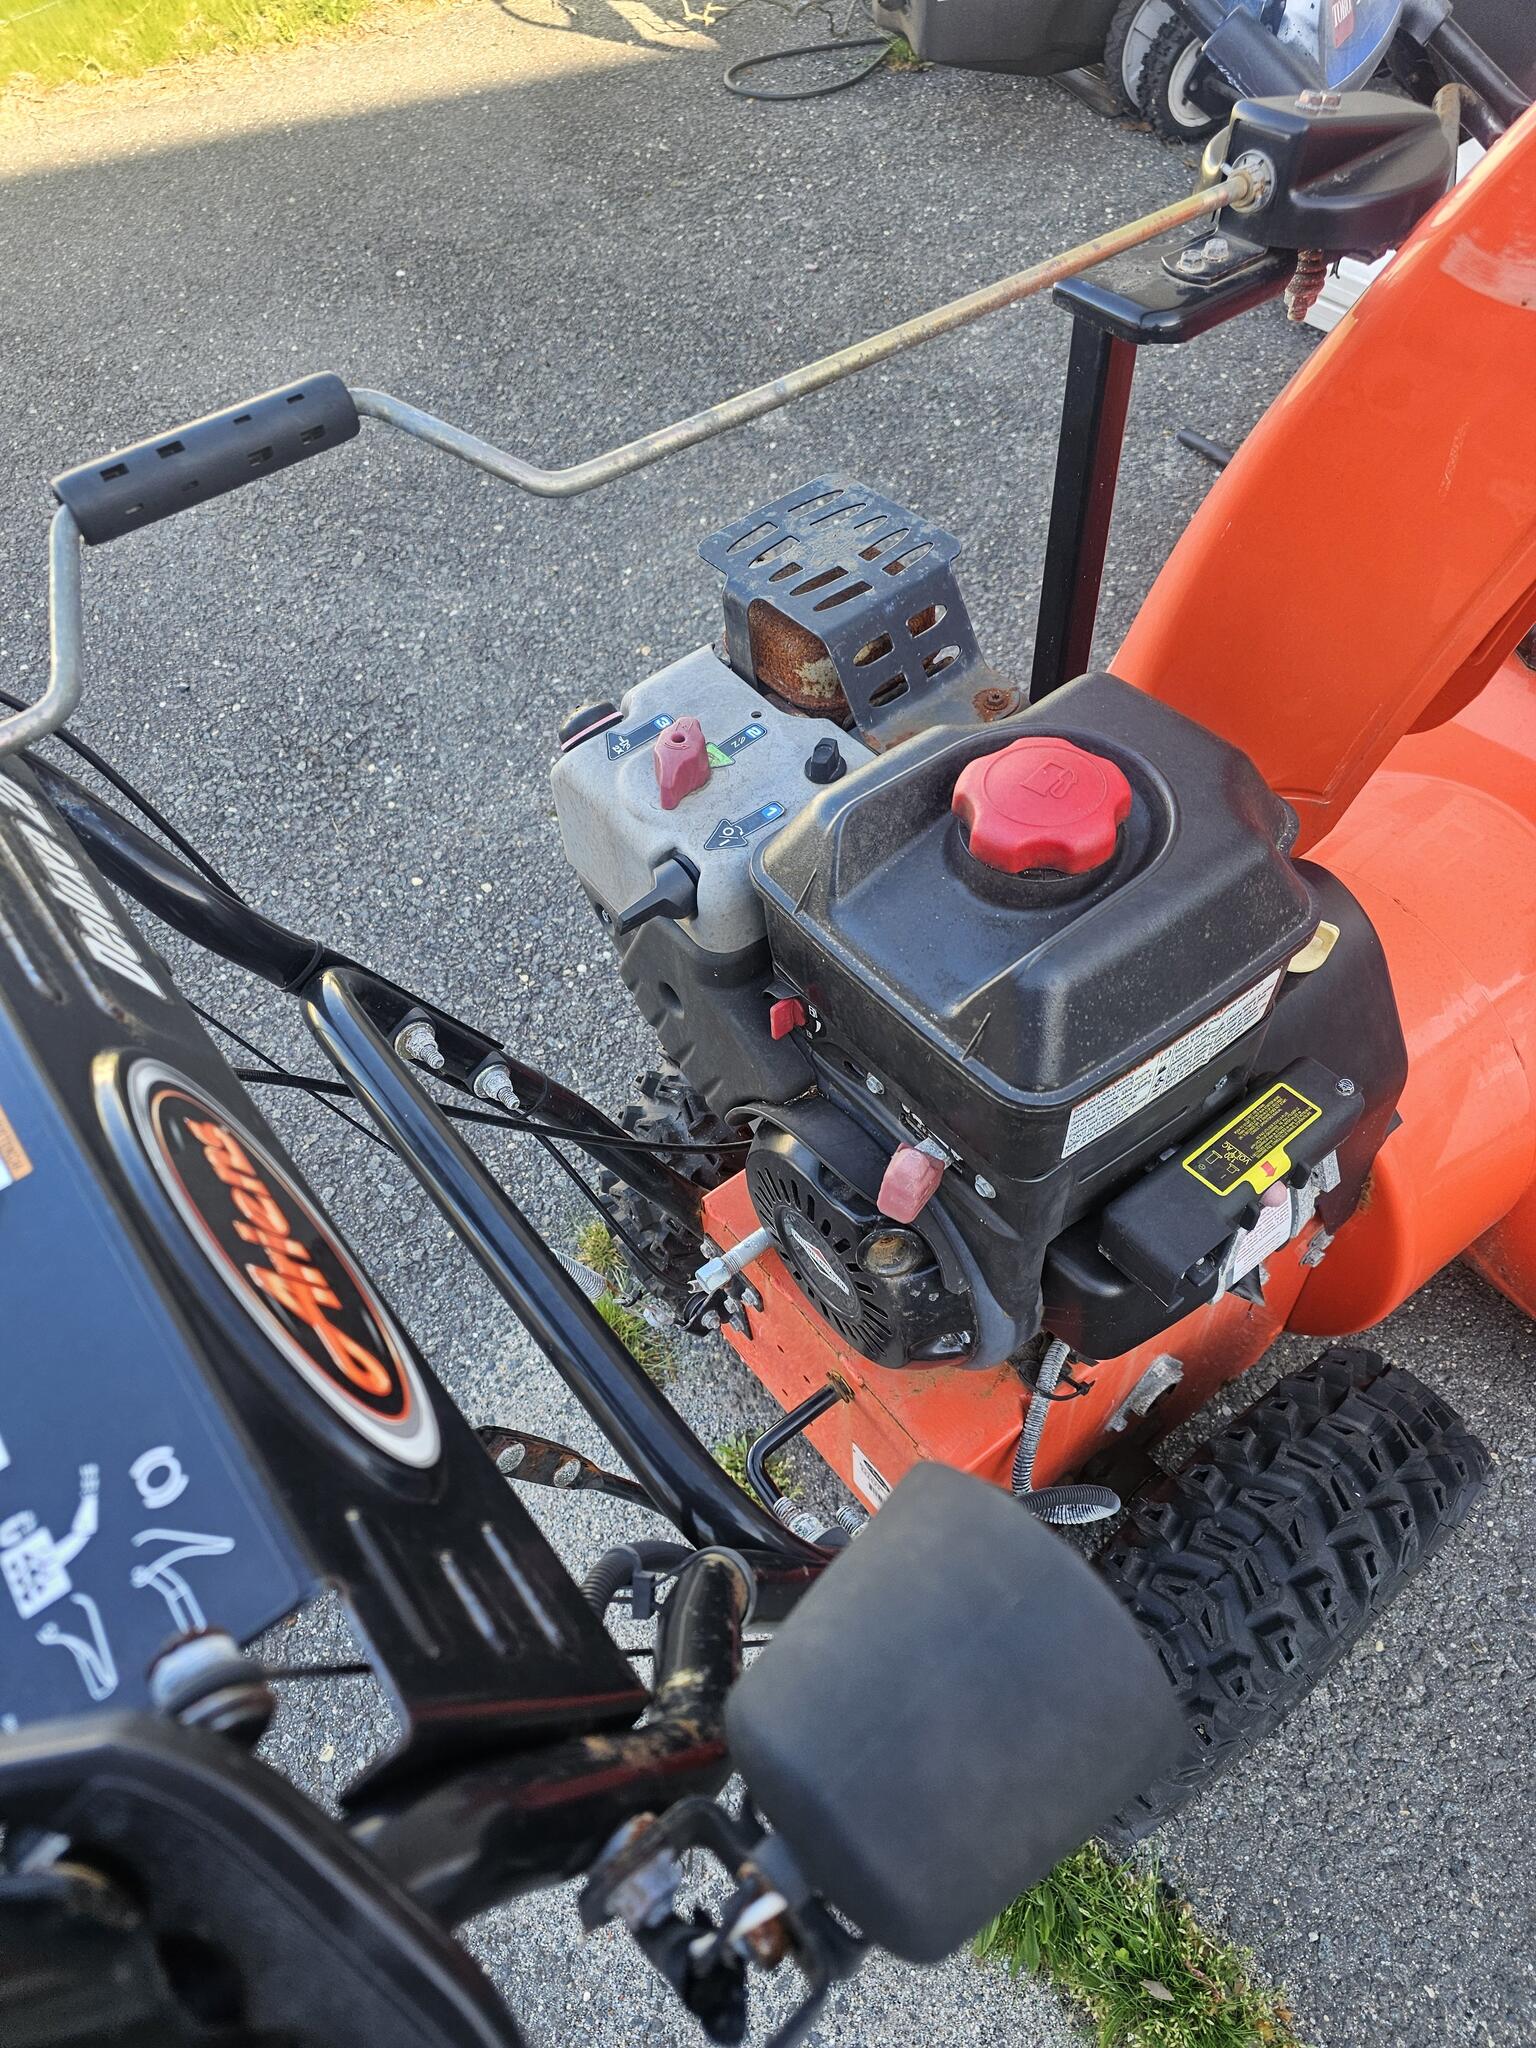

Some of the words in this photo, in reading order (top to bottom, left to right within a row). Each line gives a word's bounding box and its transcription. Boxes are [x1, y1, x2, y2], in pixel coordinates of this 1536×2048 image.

[656, 717, 670, 729] 3
[746, 727, 761, 739] 2
[766, 807, 778, 817] 1
[15, 818, 168, 1000] Deluxe
[1224, 1151, 1236, 1163] 120
[183, 1116, 392, 1397] Ariens
